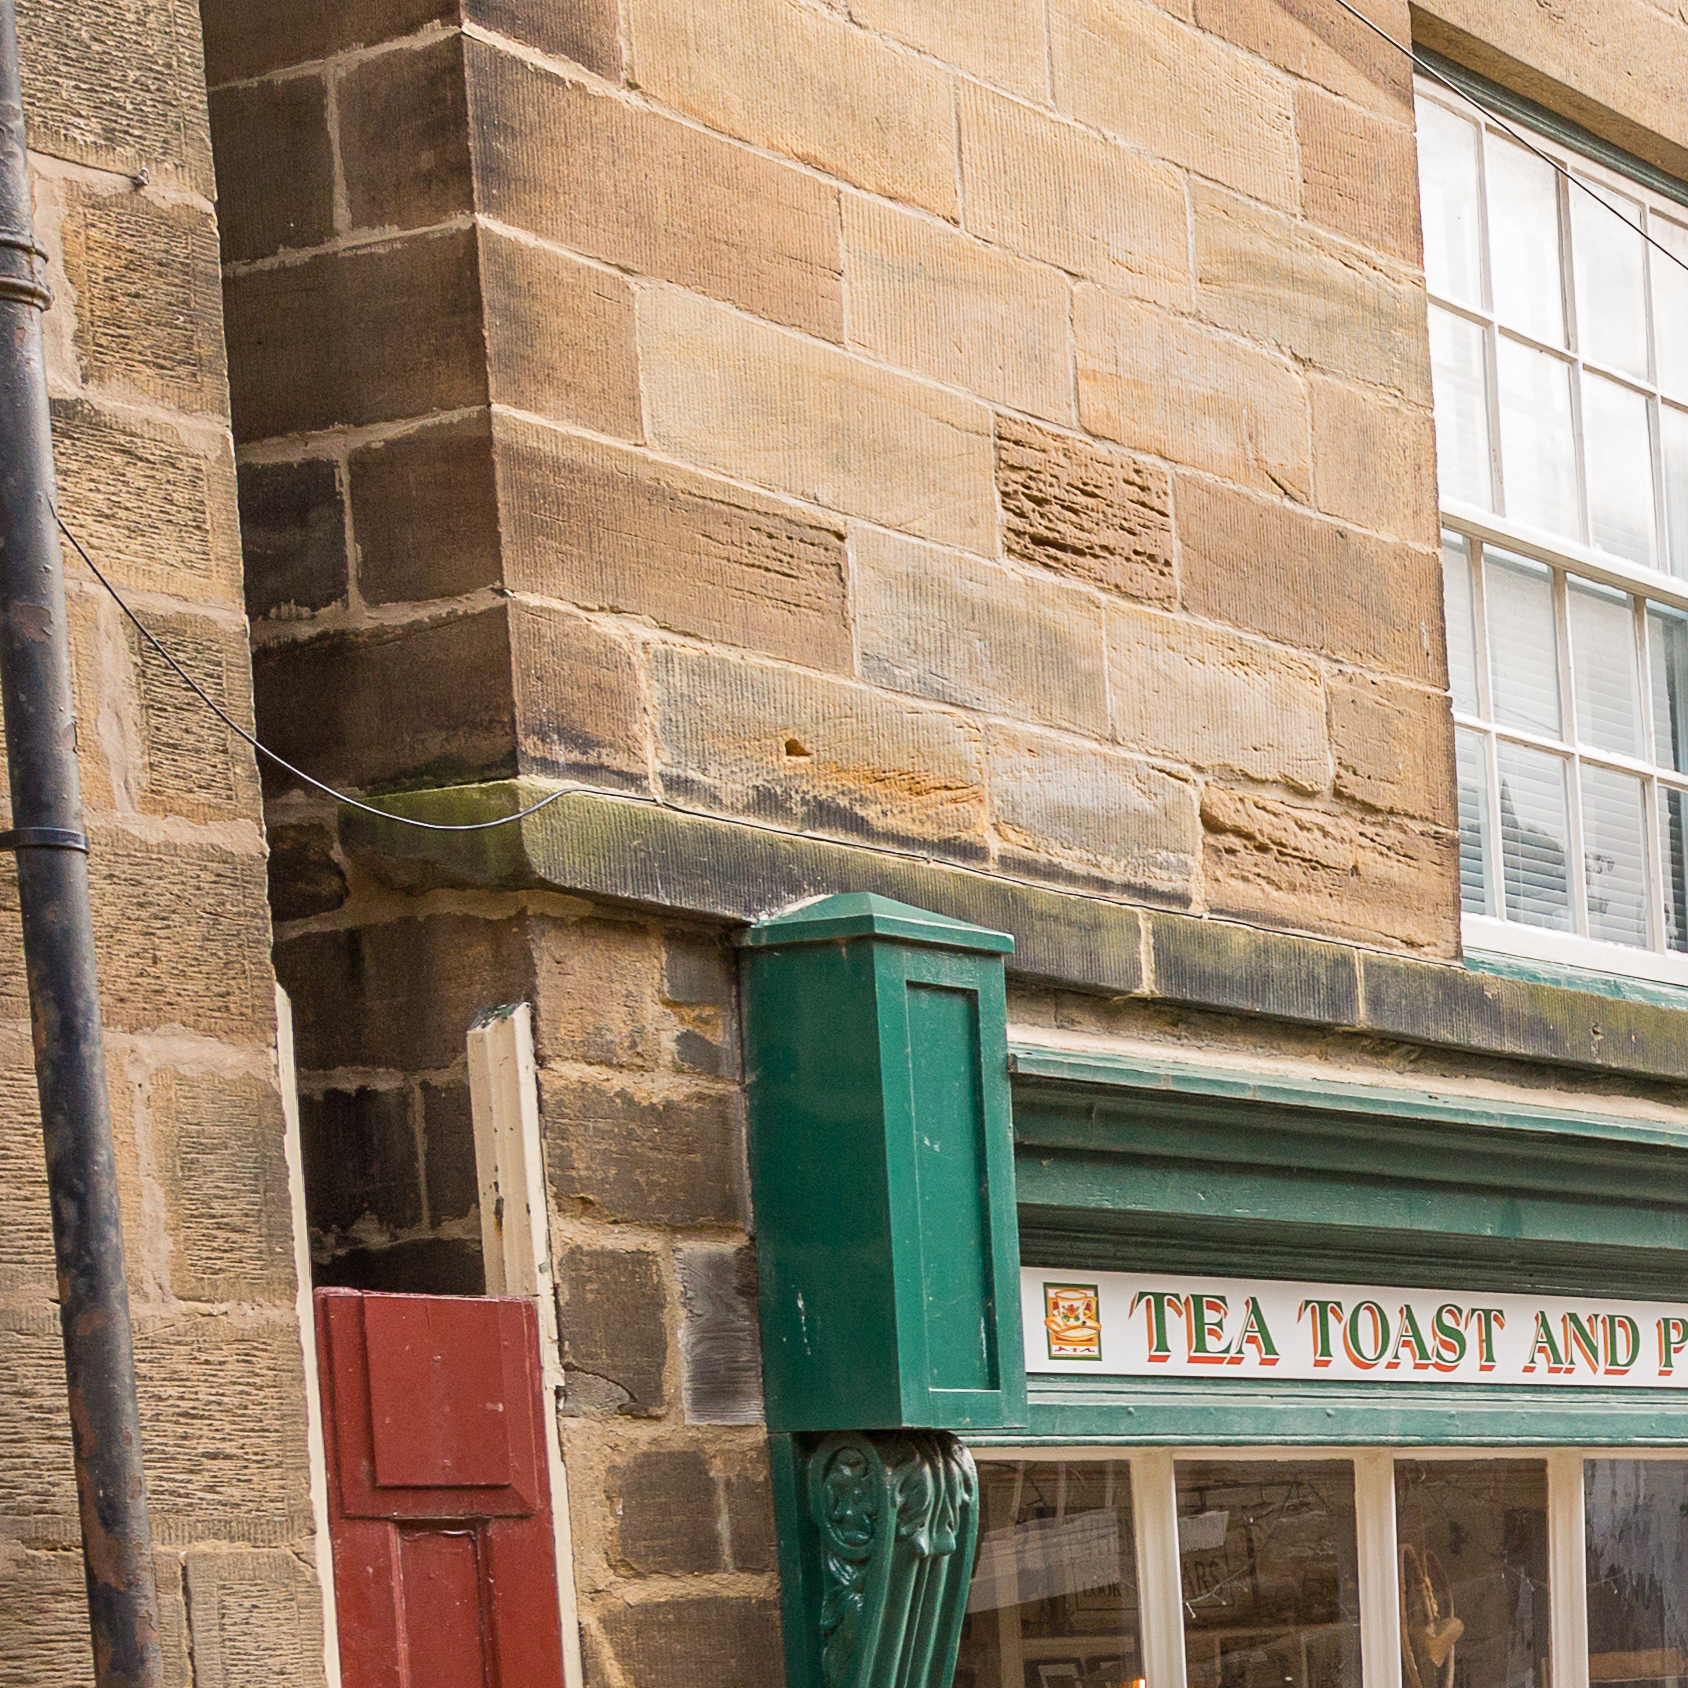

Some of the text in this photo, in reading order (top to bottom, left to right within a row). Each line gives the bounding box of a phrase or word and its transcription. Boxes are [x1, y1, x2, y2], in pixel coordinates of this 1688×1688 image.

[1128, 1291, 1281, 1366] TEA
[1297, 1299, 1506, 1373] TOAST
[1522, 1310, 1641, 1376] AND
